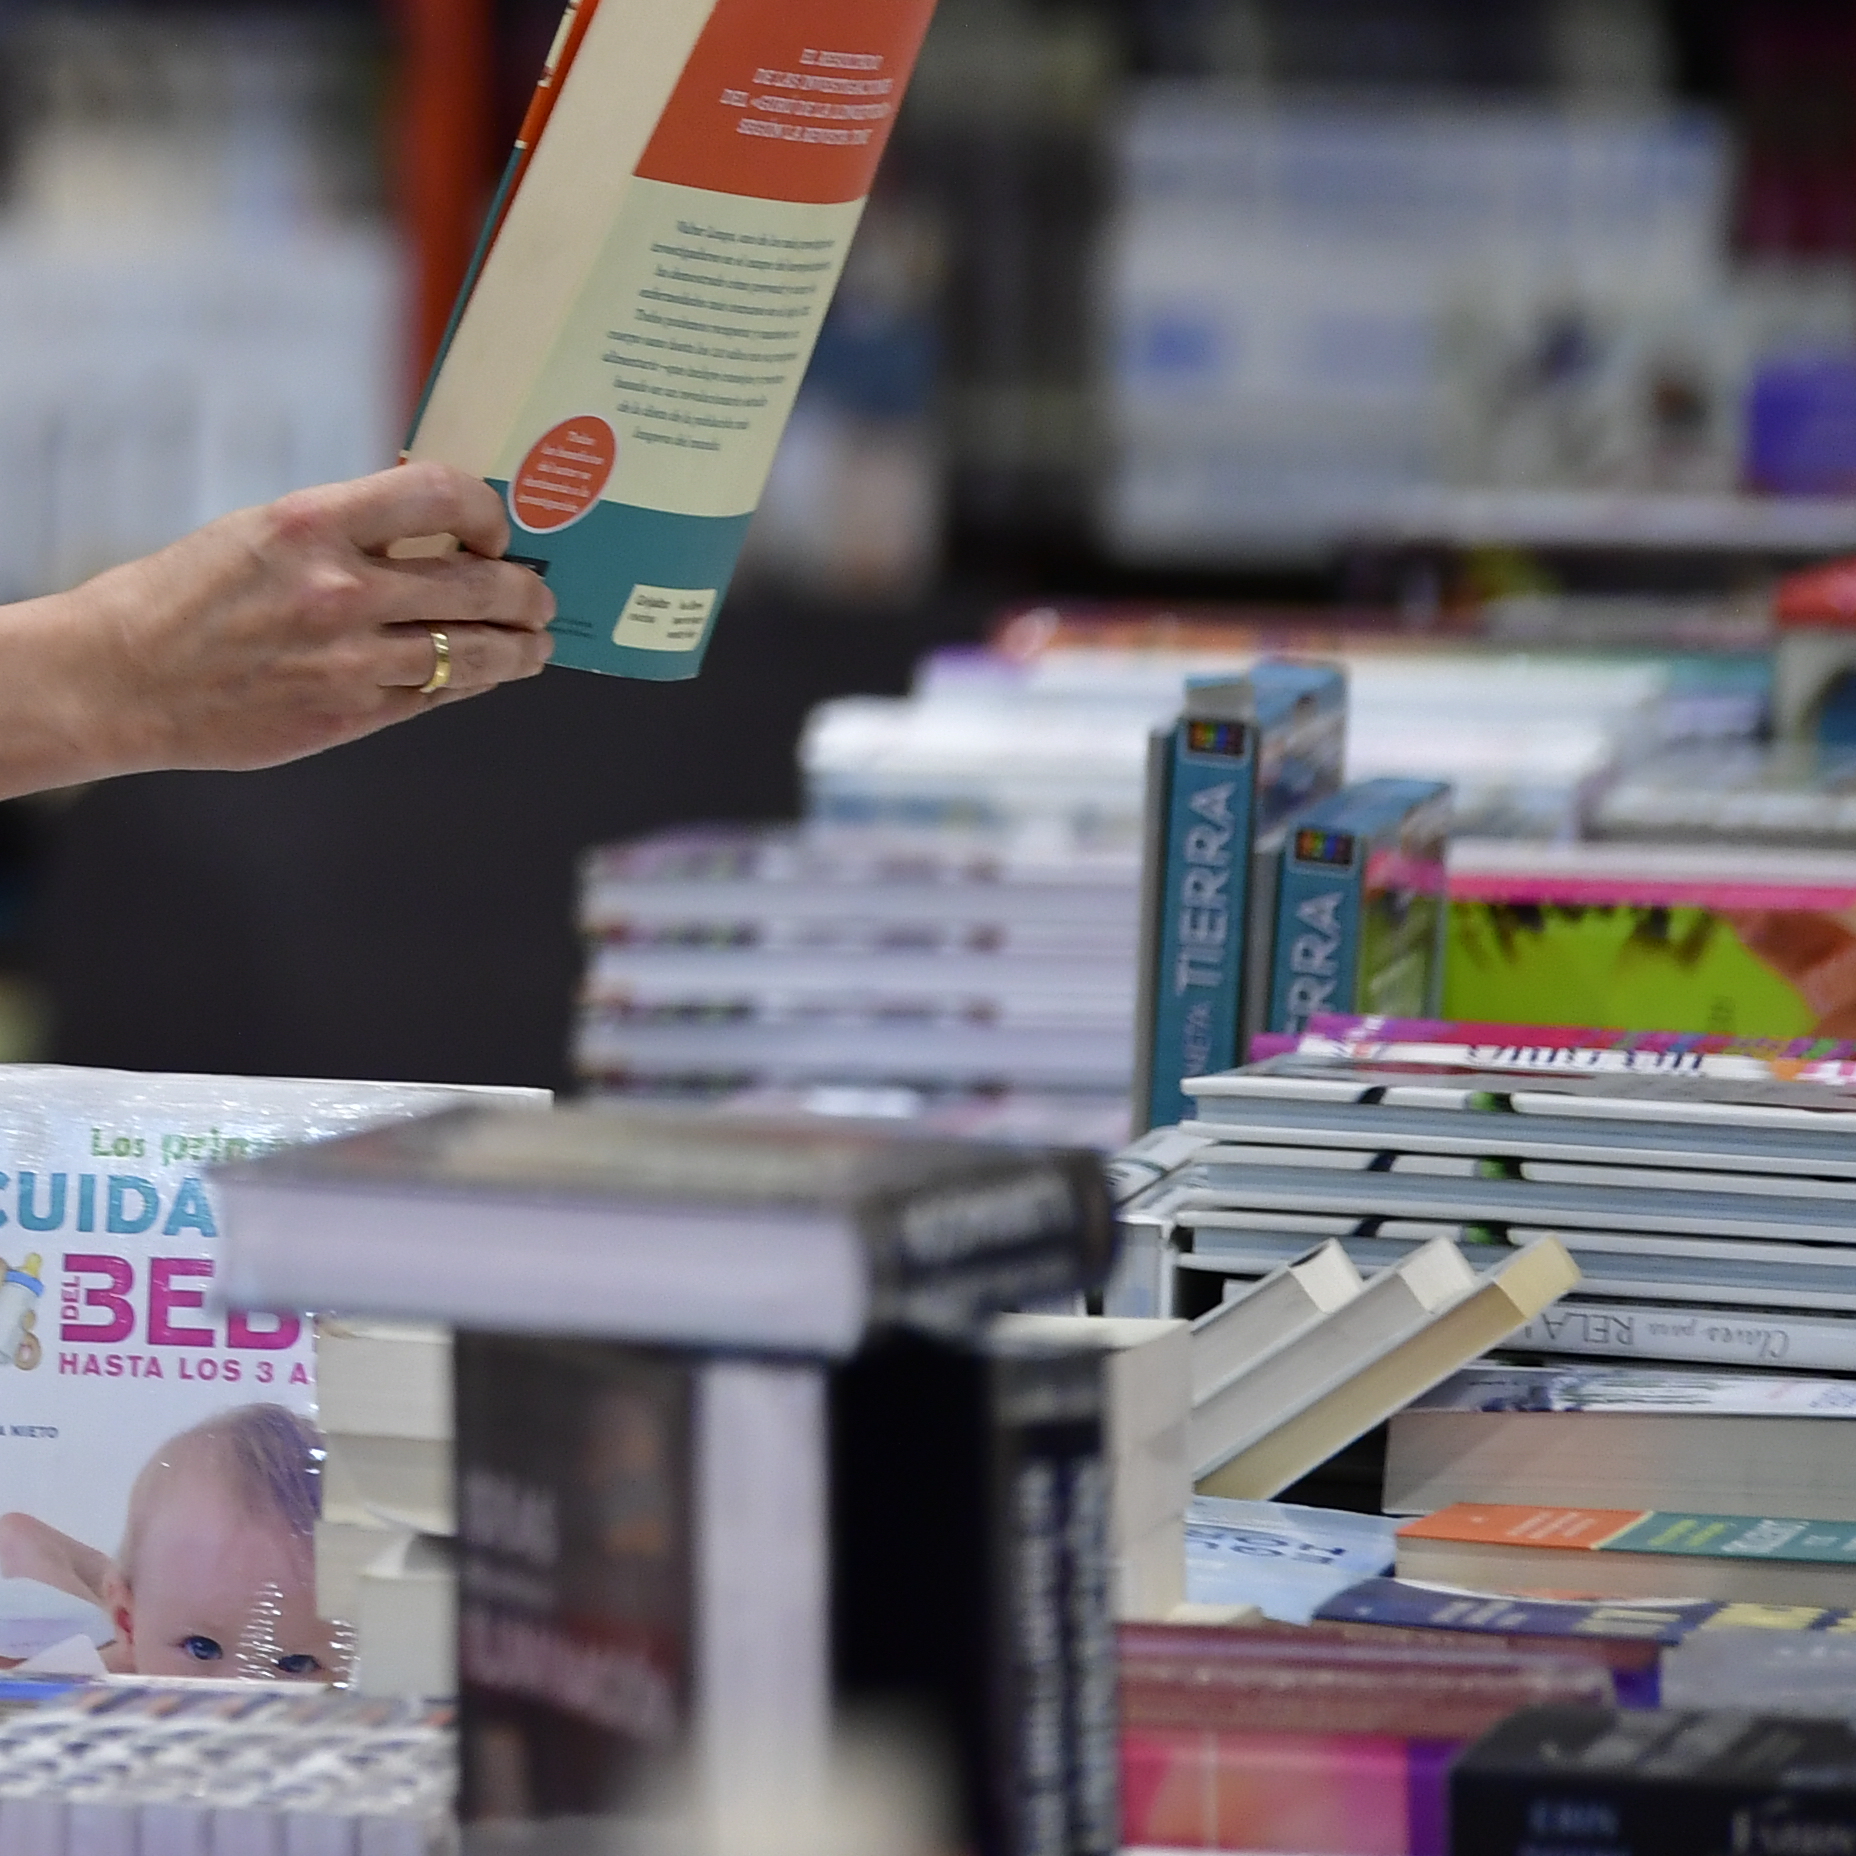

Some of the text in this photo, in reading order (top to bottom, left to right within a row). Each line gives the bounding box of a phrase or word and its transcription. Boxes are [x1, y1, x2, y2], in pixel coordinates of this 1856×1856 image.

[1174, 780, 1237, 995] TIERRA
[91, 1127, 146, 1158] Los
[60, 1275, 81, 1322] DEL
[58, 1350, 164, 1379] HASTA
[178, 1357, 243, 1382] LOS
[256, 1360, 275, 1384] 3
